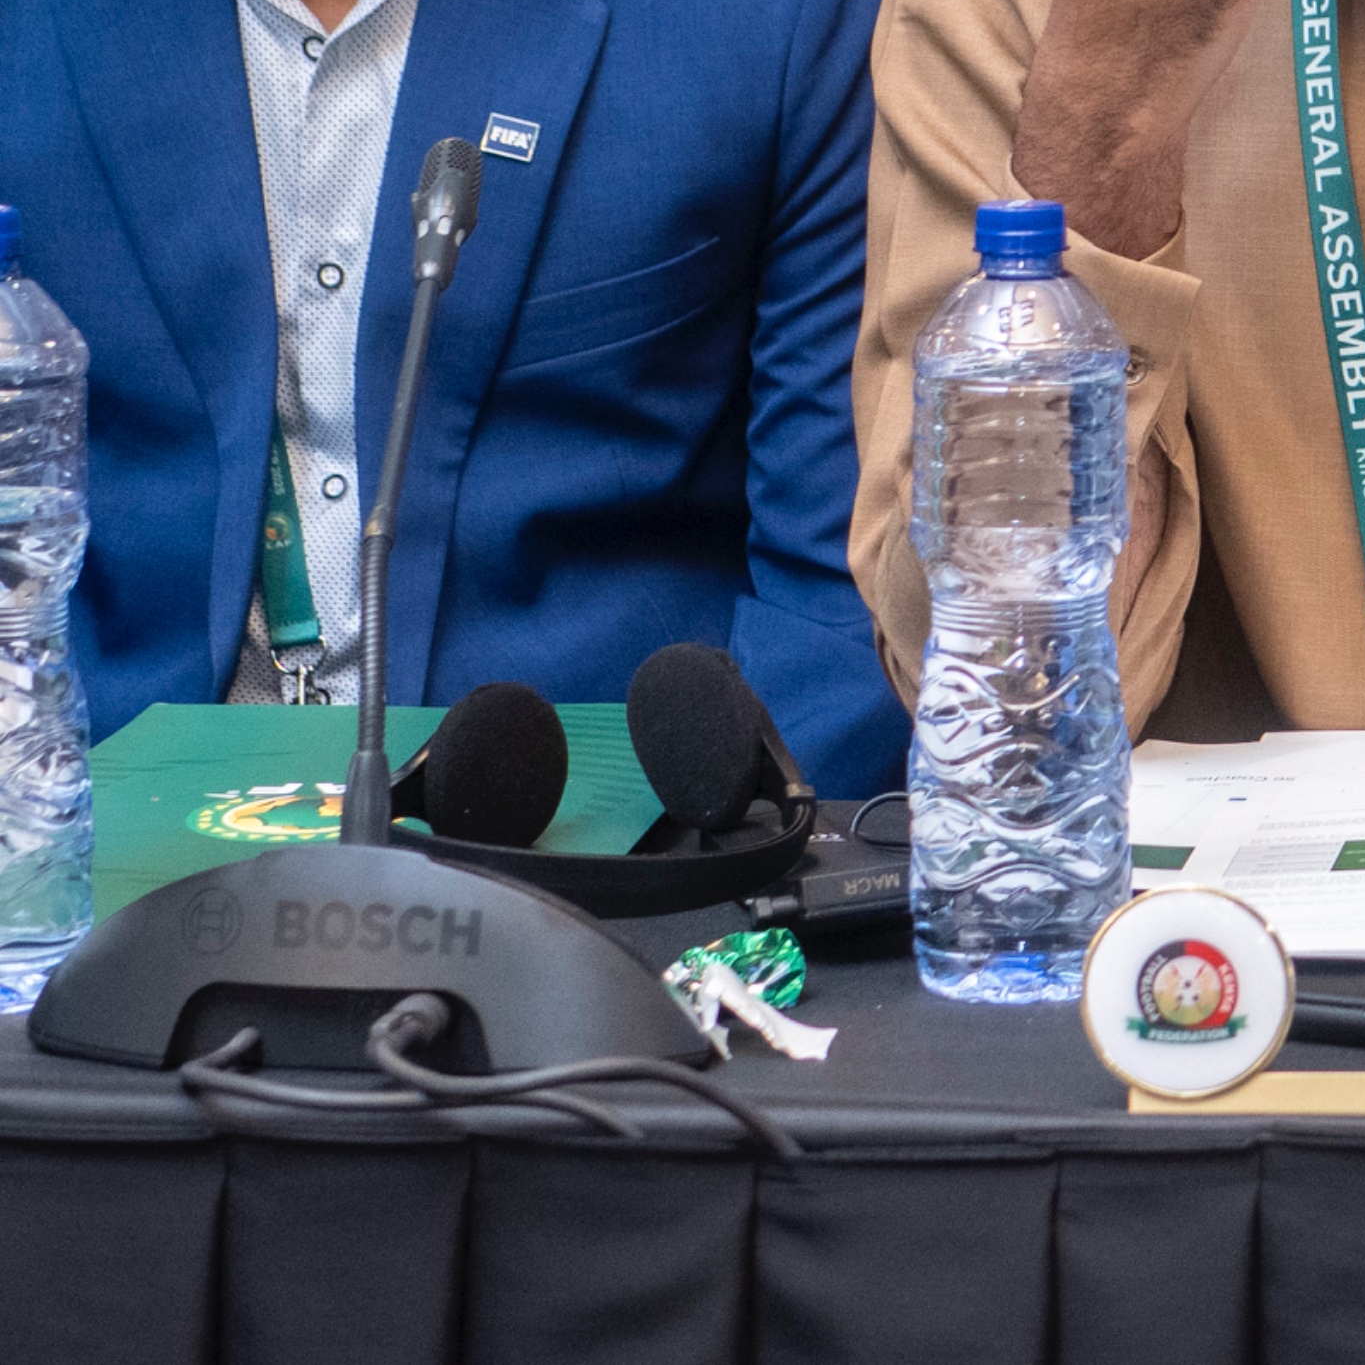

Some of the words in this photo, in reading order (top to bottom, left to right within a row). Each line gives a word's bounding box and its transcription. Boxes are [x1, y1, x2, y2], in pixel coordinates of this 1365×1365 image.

[491, 126, 528, 149] FIFA
[273, 900, 484, 956] BOSCH
[1147, 1026, 1230, 1041] FEDERATION
